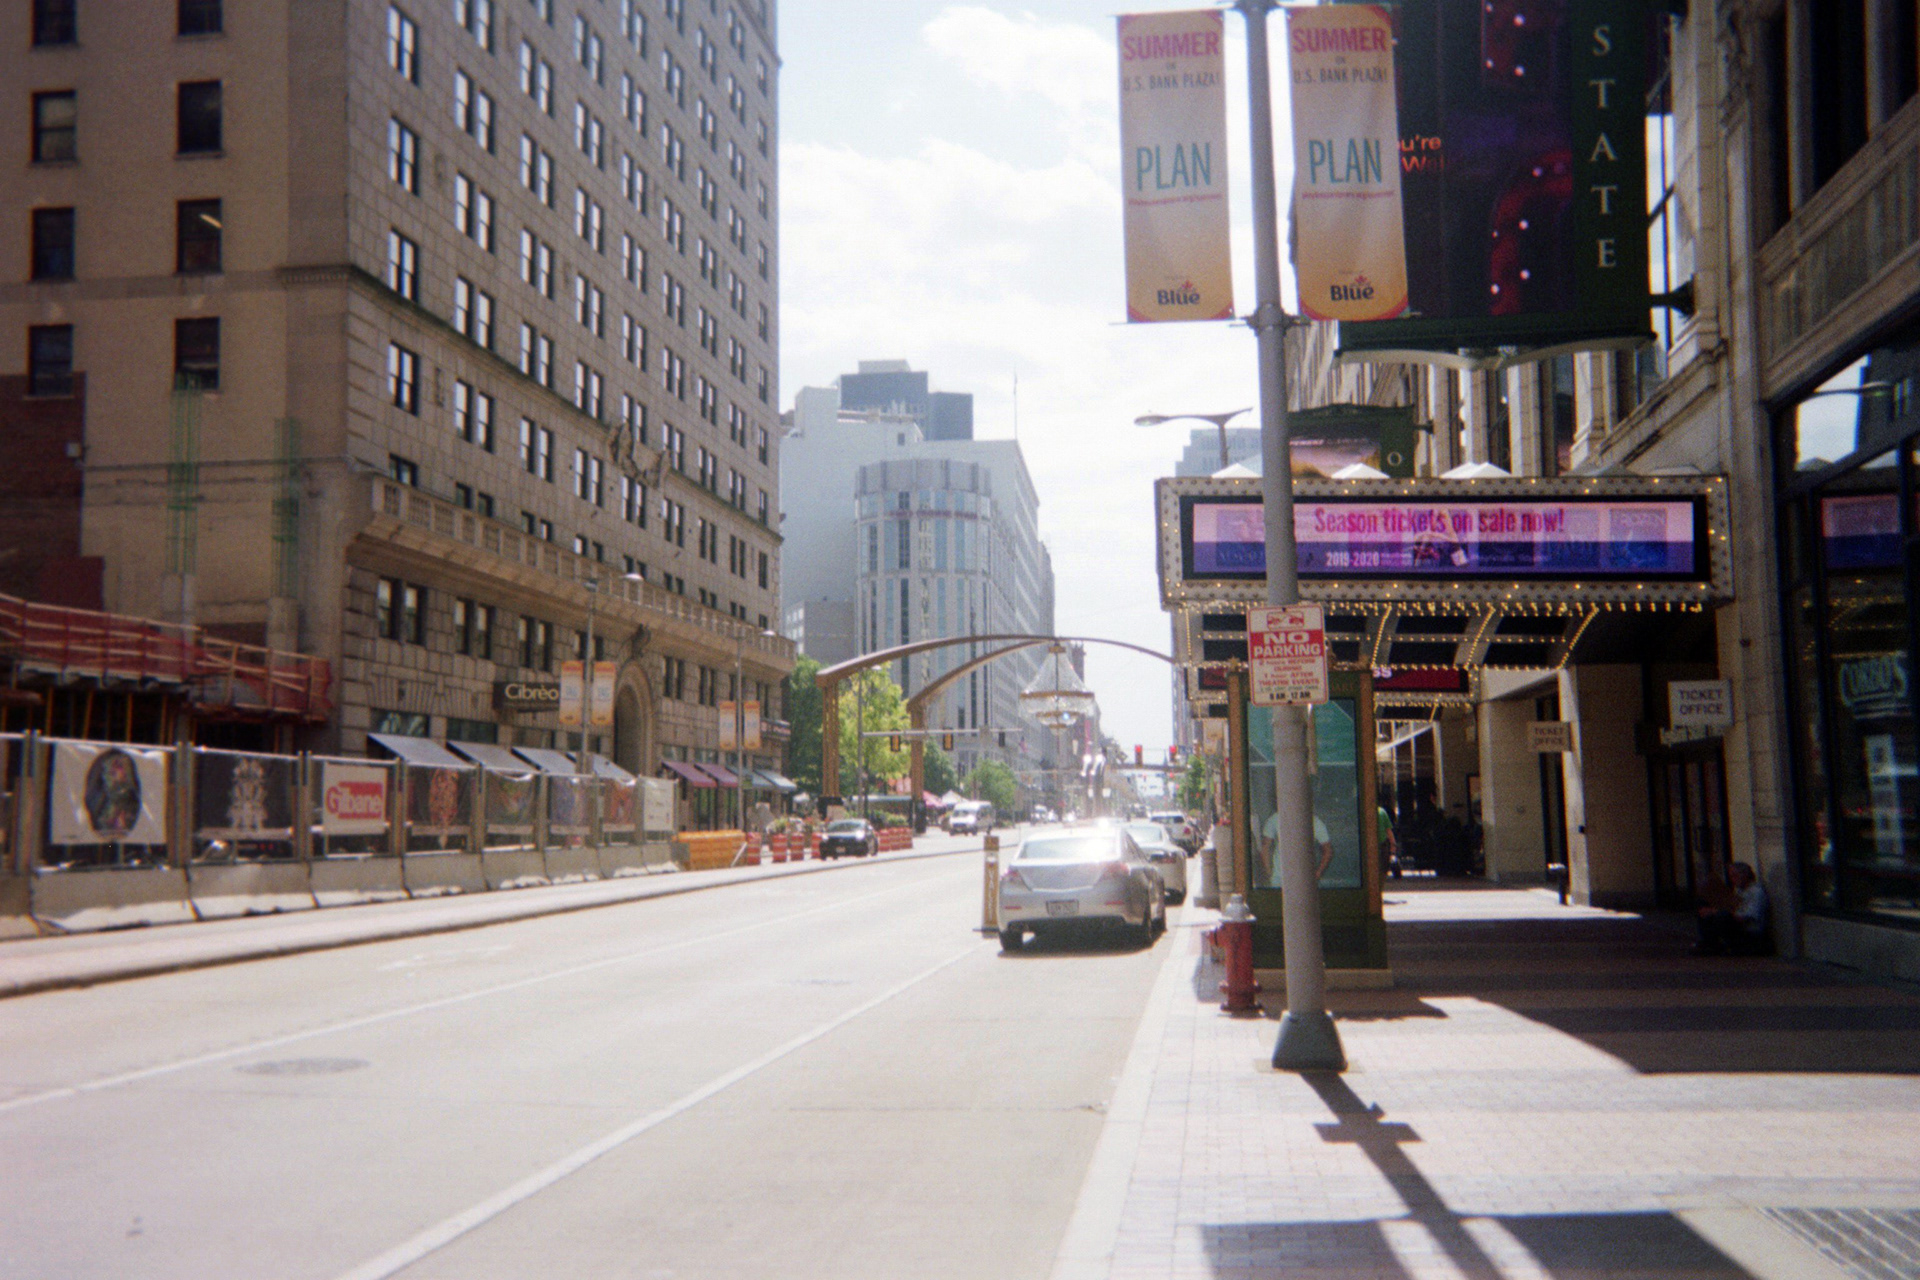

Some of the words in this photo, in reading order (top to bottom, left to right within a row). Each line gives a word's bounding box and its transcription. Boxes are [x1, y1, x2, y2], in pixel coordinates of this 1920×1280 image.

[1123, 31, 1219, 61] SUMMER
[1293, 26, 1388, 52] SUMMER
[1123, 77, 1144, 92] U.S.
[1150, 75, 1179, 89] BANK
[1294, 69, 1317, 84] U.S.
[1320, 68, 1348, 82] BANK
[1399, 134, 1441, 152] u're
[1588, 24, 1618, 268] STATE
[1135, 142, 1212, 191] PLAN
[1308, 138, 1382, 184] PLAN
[1157, 288, 1200, 306] Blue
[1330, 284, 1374, 302] Blue
[1314, 507, 1377, 533] Season
[1383, 507, 1446, 533] tickets
[1452, 512, 1473, 532] on
[1479, 508, 1517, 532] sale
[1521, 508, 1565, 532] now!
[1325, 551, 1380, 567] 2019-2020
[1263, 631, 1310, 645] NO
[1253, 643, 1321, 658] PARKING
[1679, 688, 1723, 700] TICKET
[1680, 703, 1724, 715] OFFICE
